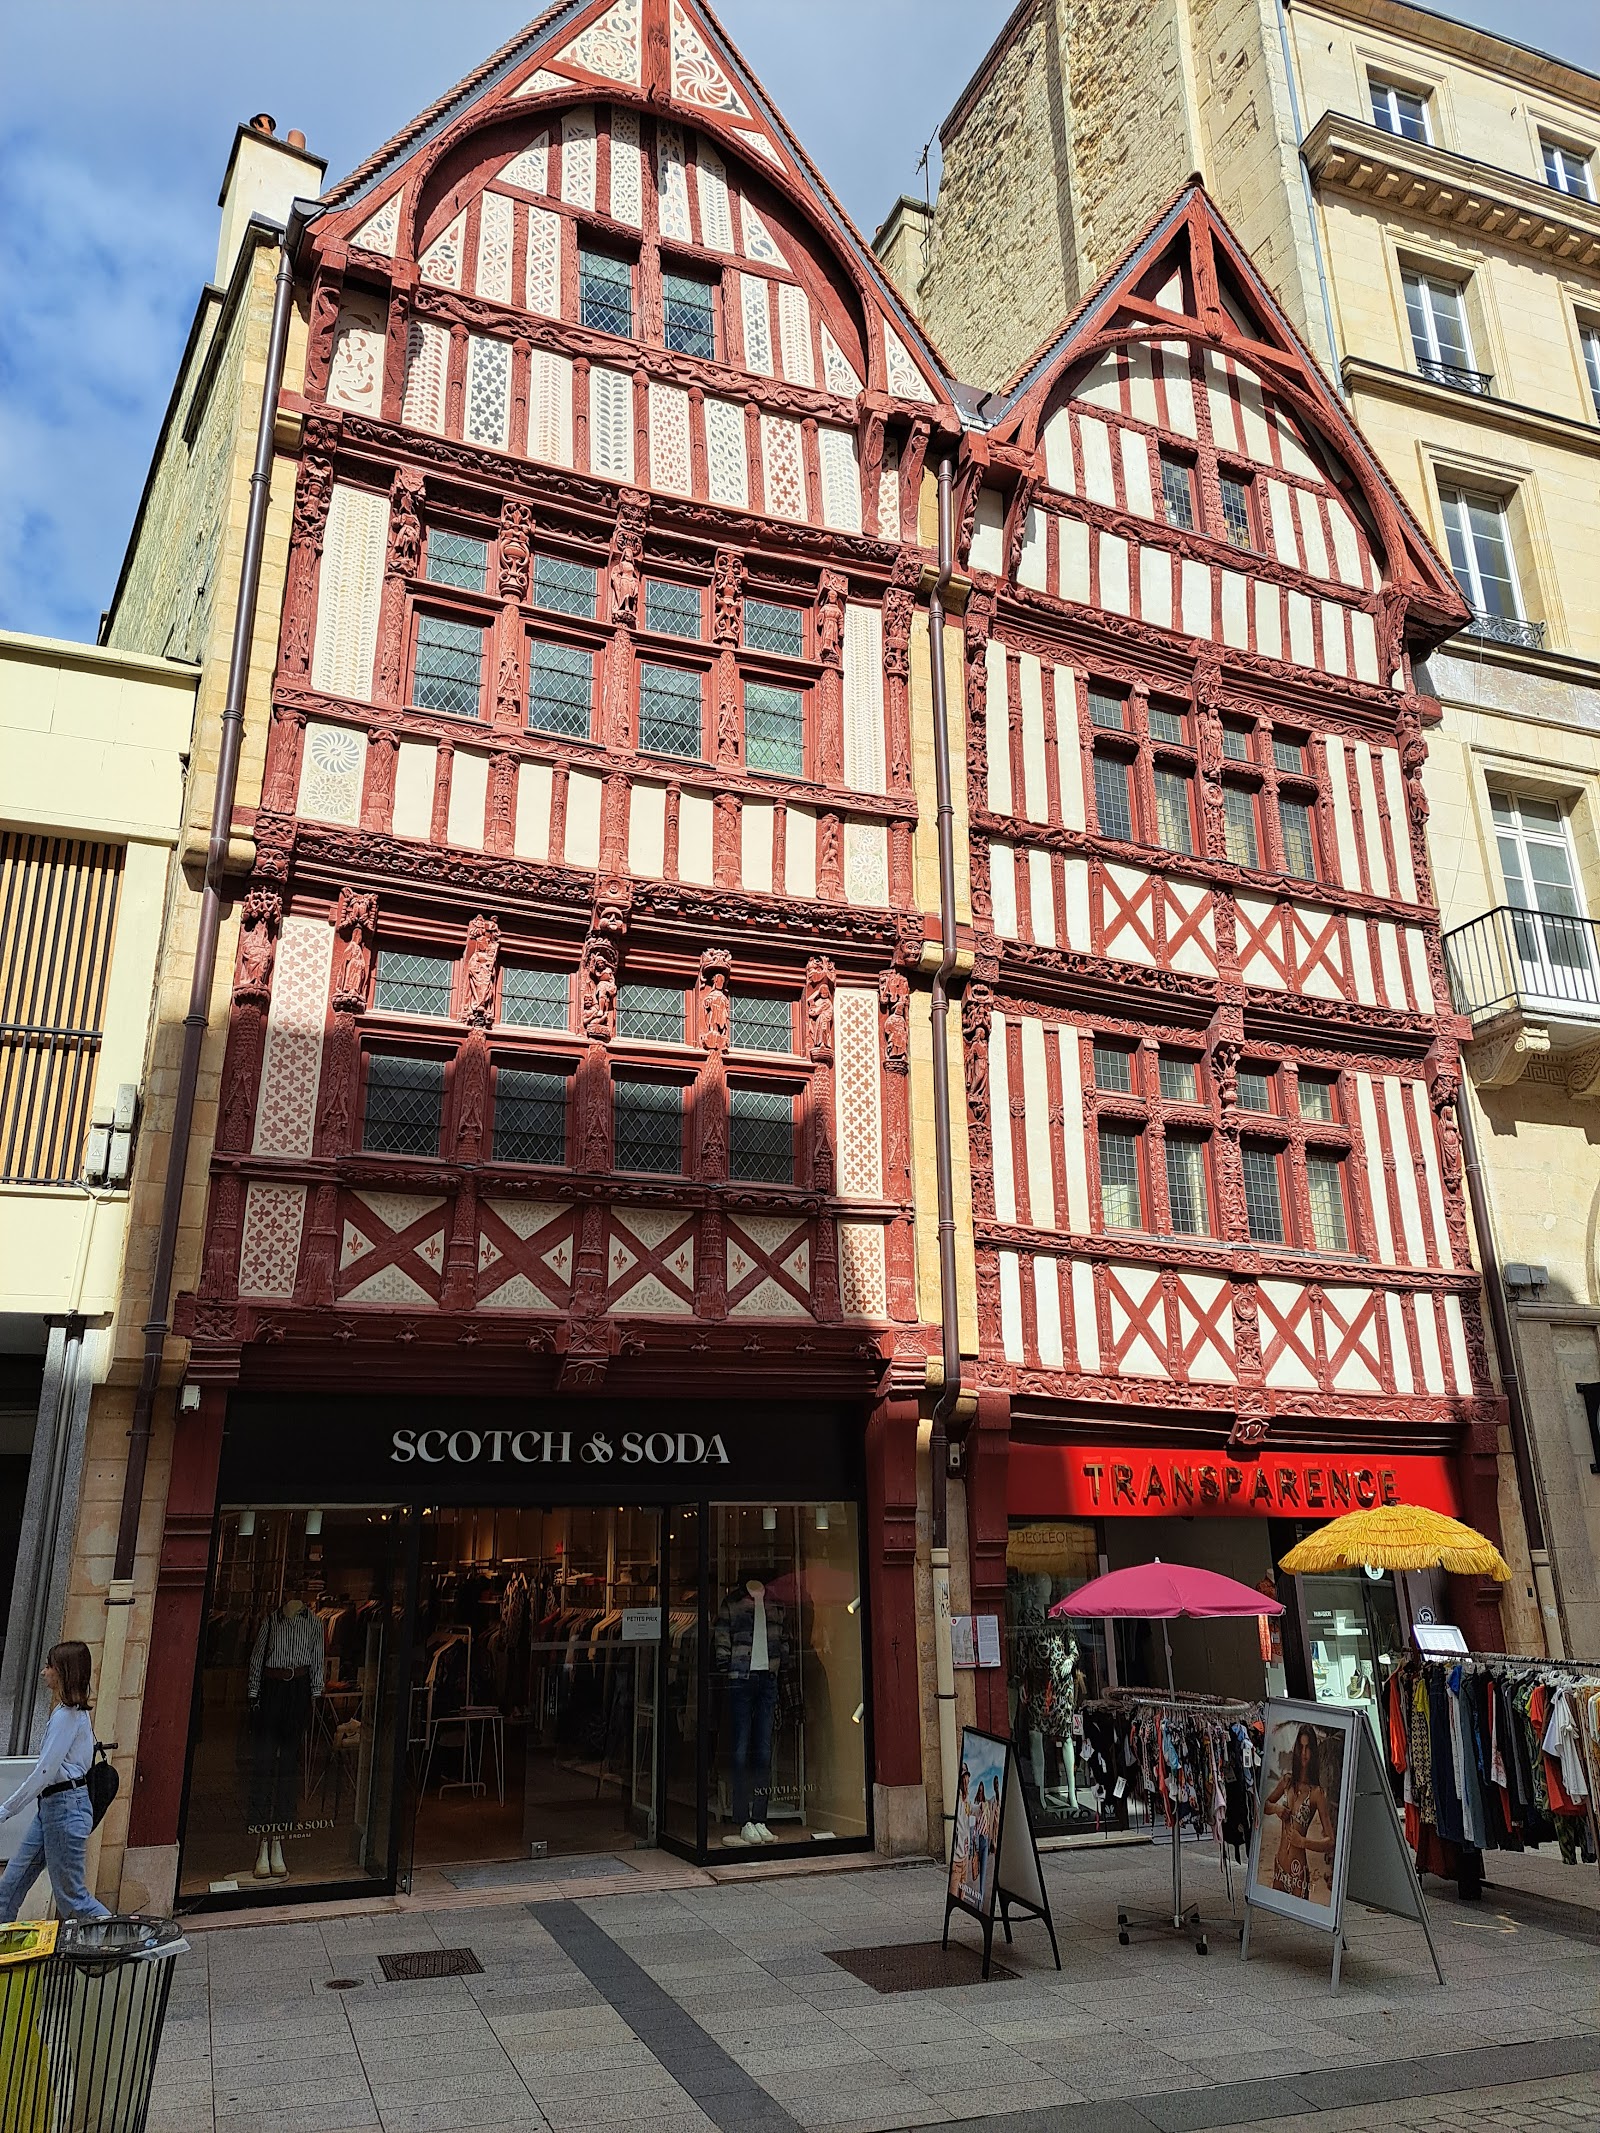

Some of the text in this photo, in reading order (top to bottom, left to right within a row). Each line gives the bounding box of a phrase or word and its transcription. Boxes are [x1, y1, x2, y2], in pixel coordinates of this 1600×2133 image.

[391, 1430, 730, 1464] SCOTCH & SODA
[1083, 1463, 1401, 1507] TRANSPARENCE
[753, 1785, 790, 1796] SCOTCH
[773, 1794, 804, 1802] AMSTERDA
[247, 1819, 335, 1834] SCOTCH & SODA
[1273, 1872, 1316, 1892] WATERCULT
